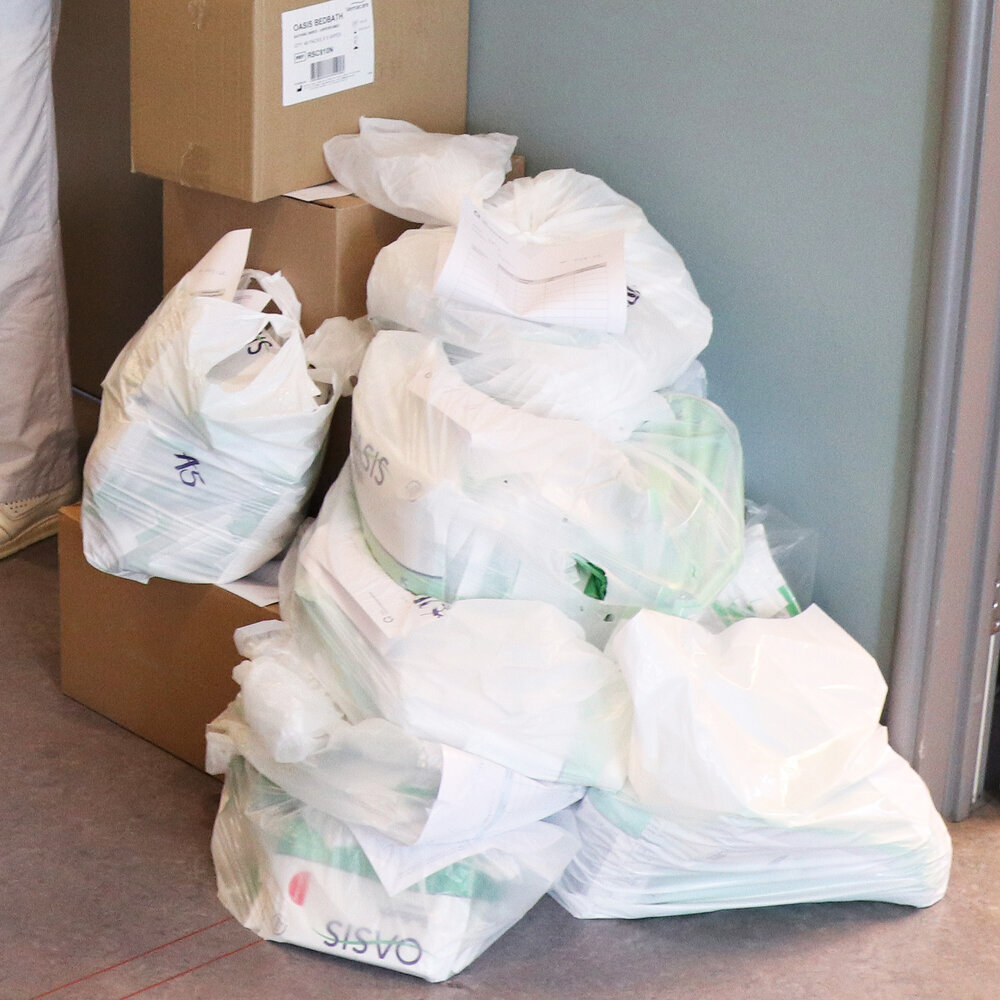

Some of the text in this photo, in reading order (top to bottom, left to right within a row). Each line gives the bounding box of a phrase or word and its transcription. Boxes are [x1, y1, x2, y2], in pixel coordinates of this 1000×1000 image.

[293, 20, 313, 32] OASIS
[314, 12, 343, 27] BEDBATH
[323, 920, 422, 966] OASIS
